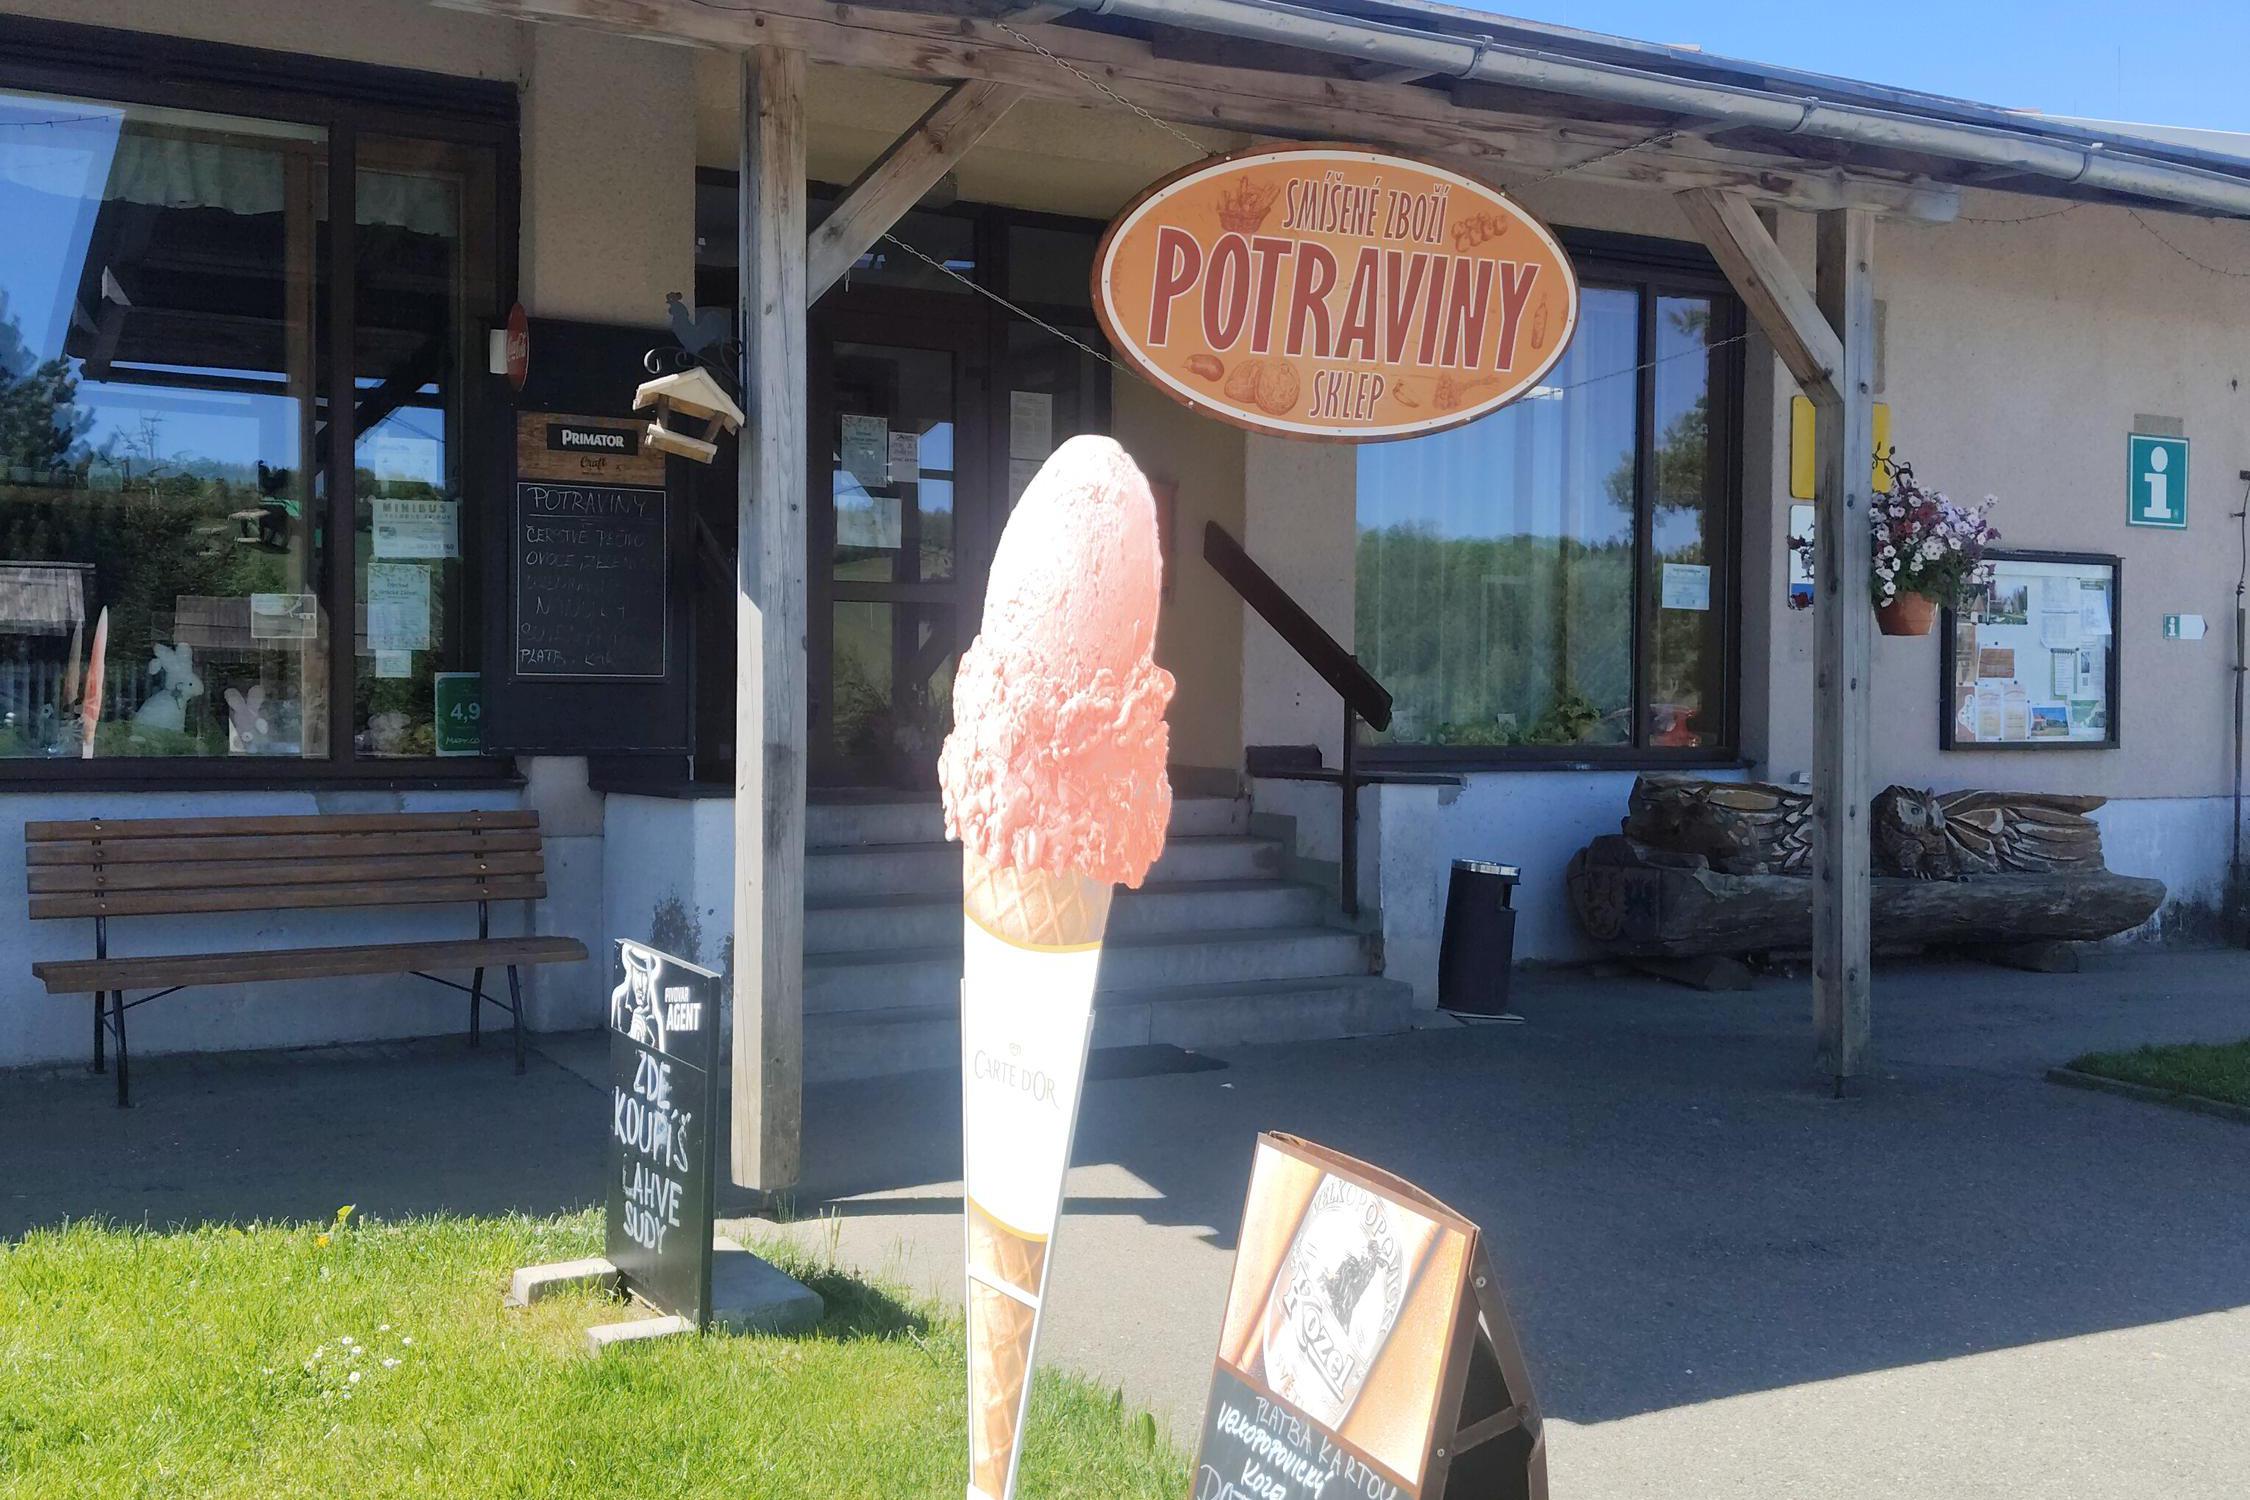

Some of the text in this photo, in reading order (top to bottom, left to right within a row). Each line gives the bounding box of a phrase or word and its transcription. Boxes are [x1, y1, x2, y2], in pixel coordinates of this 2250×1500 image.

[1281, 171, 1453, 245] SMÍŠENÉ ZBOŽÍ
[1146, 225, 1542, 373] POTRAVINY
[1308, 369, 1386, 422] SKLEP
[527, 486, 646, 517] POTRAVINY
[450, 702, 480, 724] 4,9
[666, 1003, 703, 1031] AGENT
[633, 1049, 671, 1111] ZDE
[974, 1049, 1017, 1088] CARTE
[613, 1085, 692, 1173] KOUPÍŠ
[623, 1200, 667, 1255] SUDY
[1255, 1396, 1312, 1456] PLATBA
[1318, 1435, 1398, 1500] KARTOU
